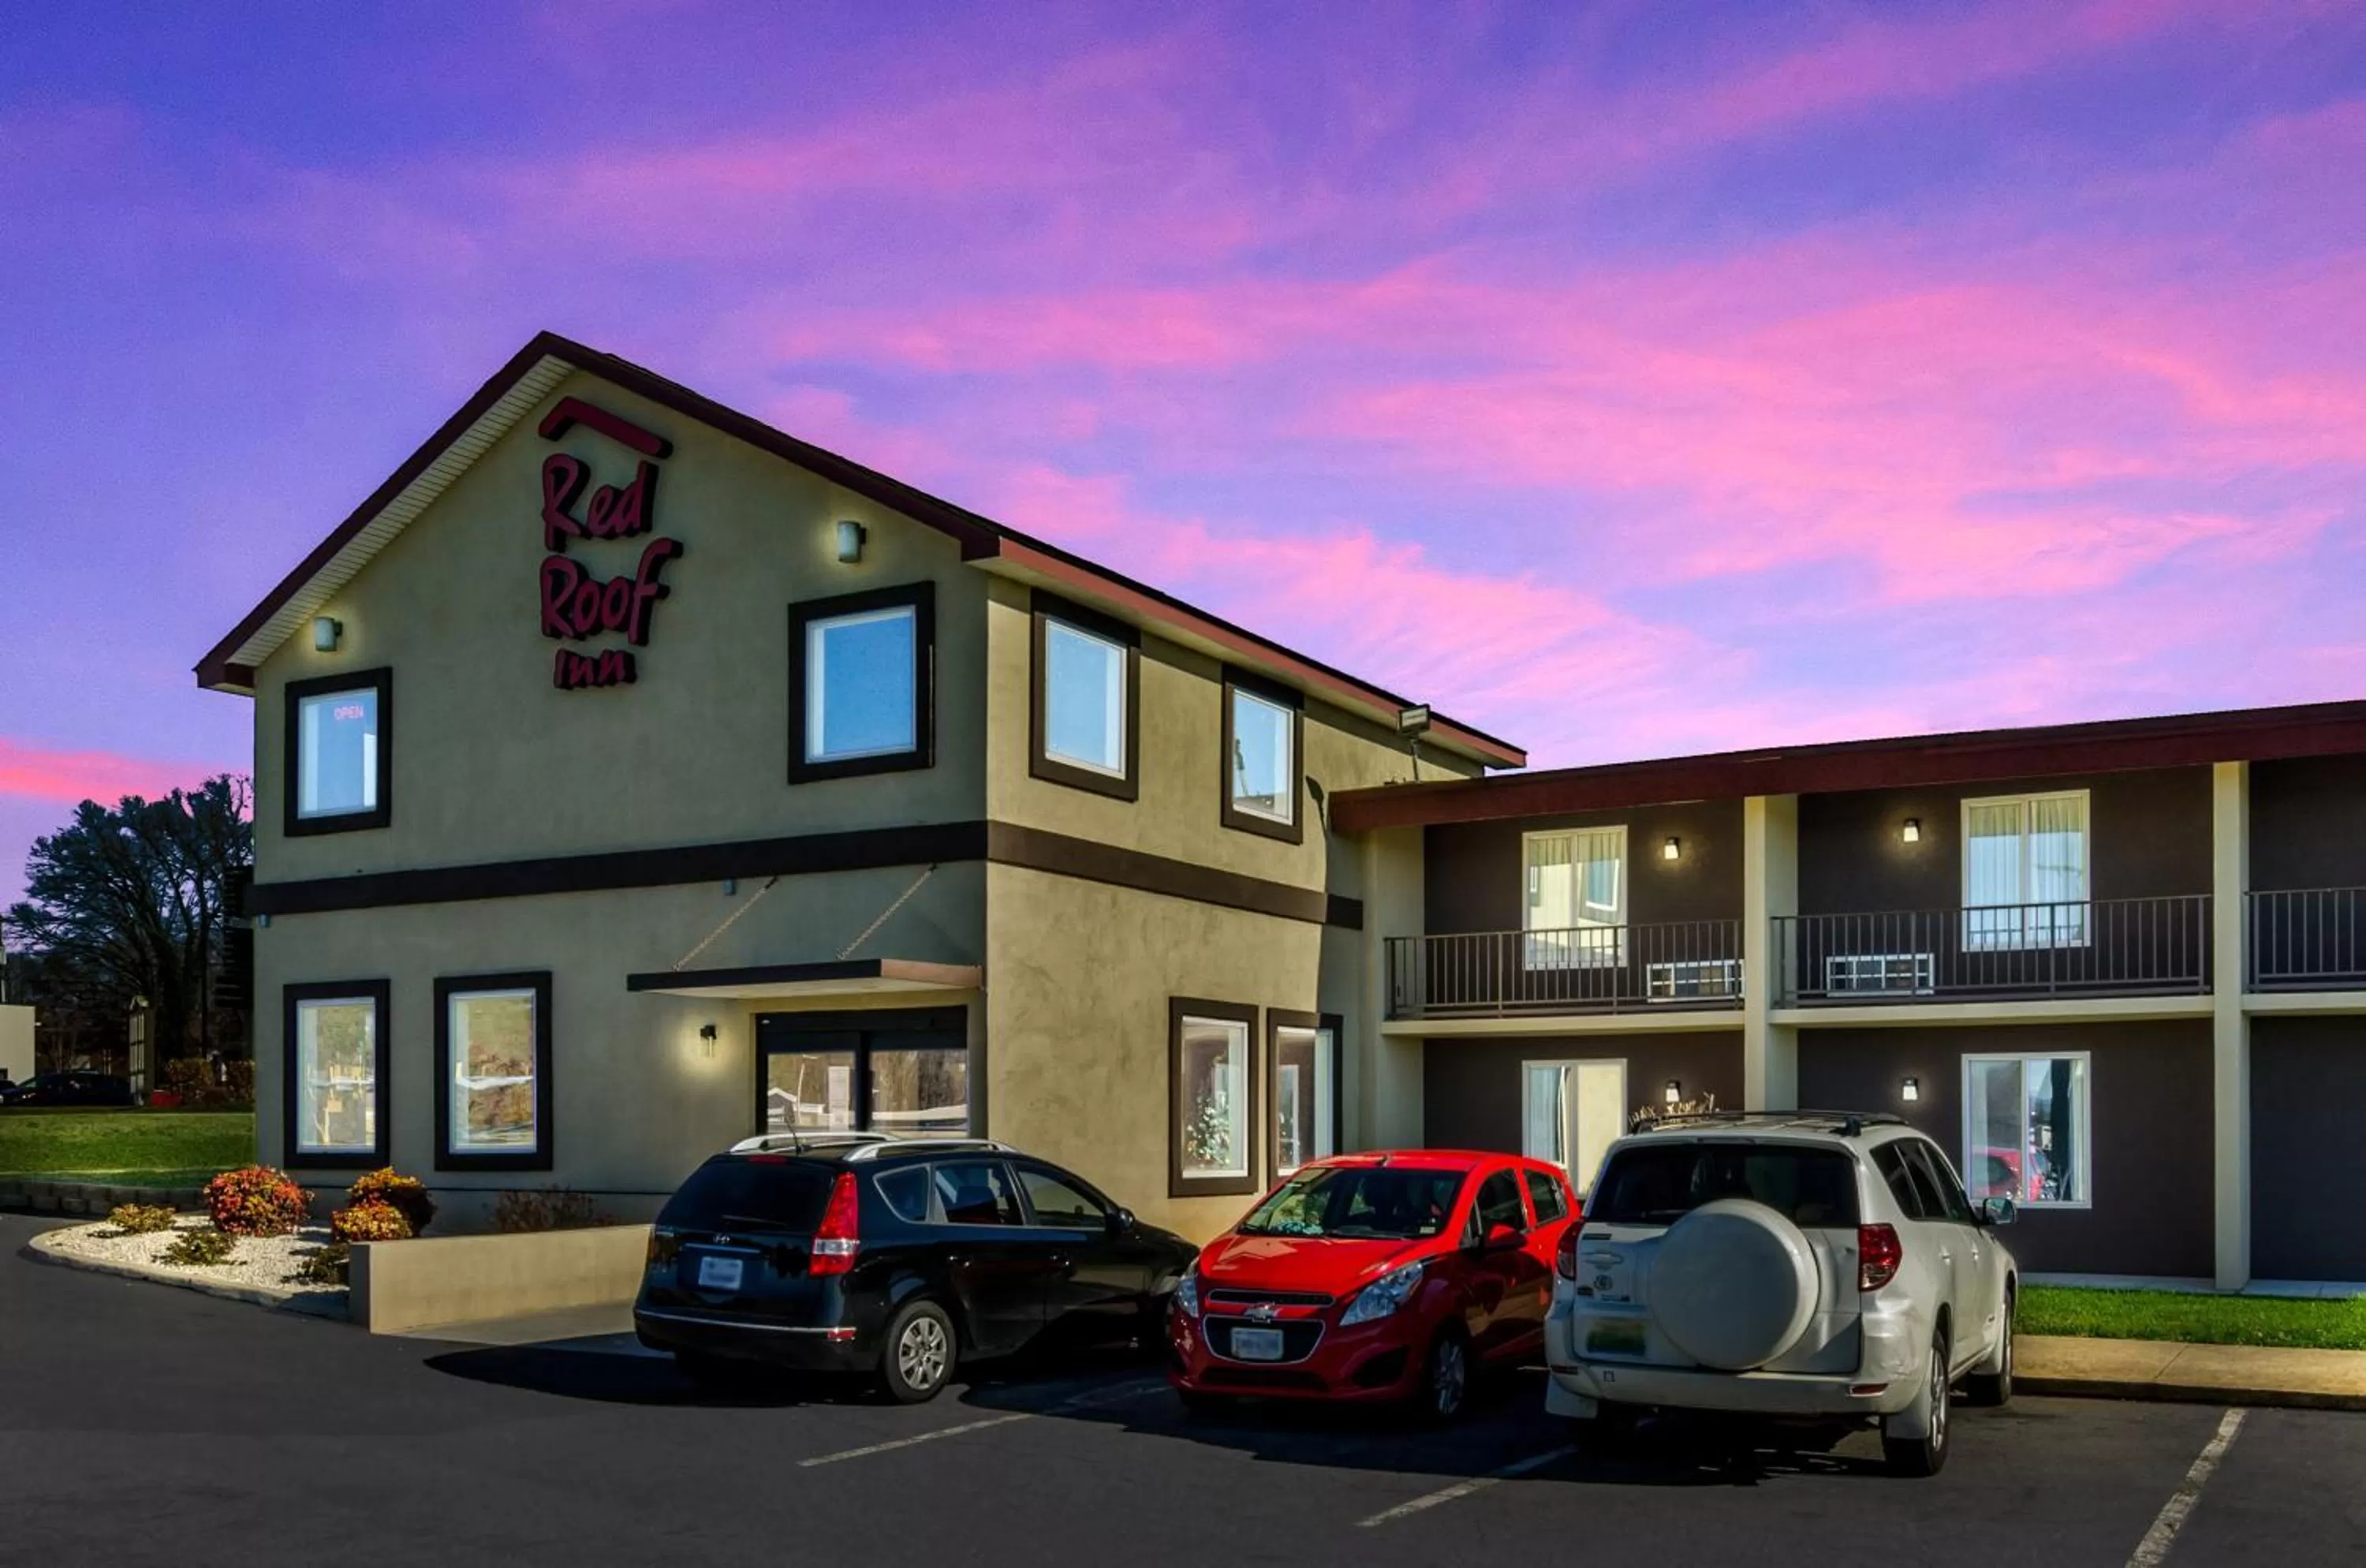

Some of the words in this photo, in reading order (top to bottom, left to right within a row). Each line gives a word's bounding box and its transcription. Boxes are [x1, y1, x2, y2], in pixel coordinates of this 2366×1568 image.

[542, 453, 659, 552] Red
[539, 537, 684, 646] Roof
[334, 705, 364, 720] OPEN
